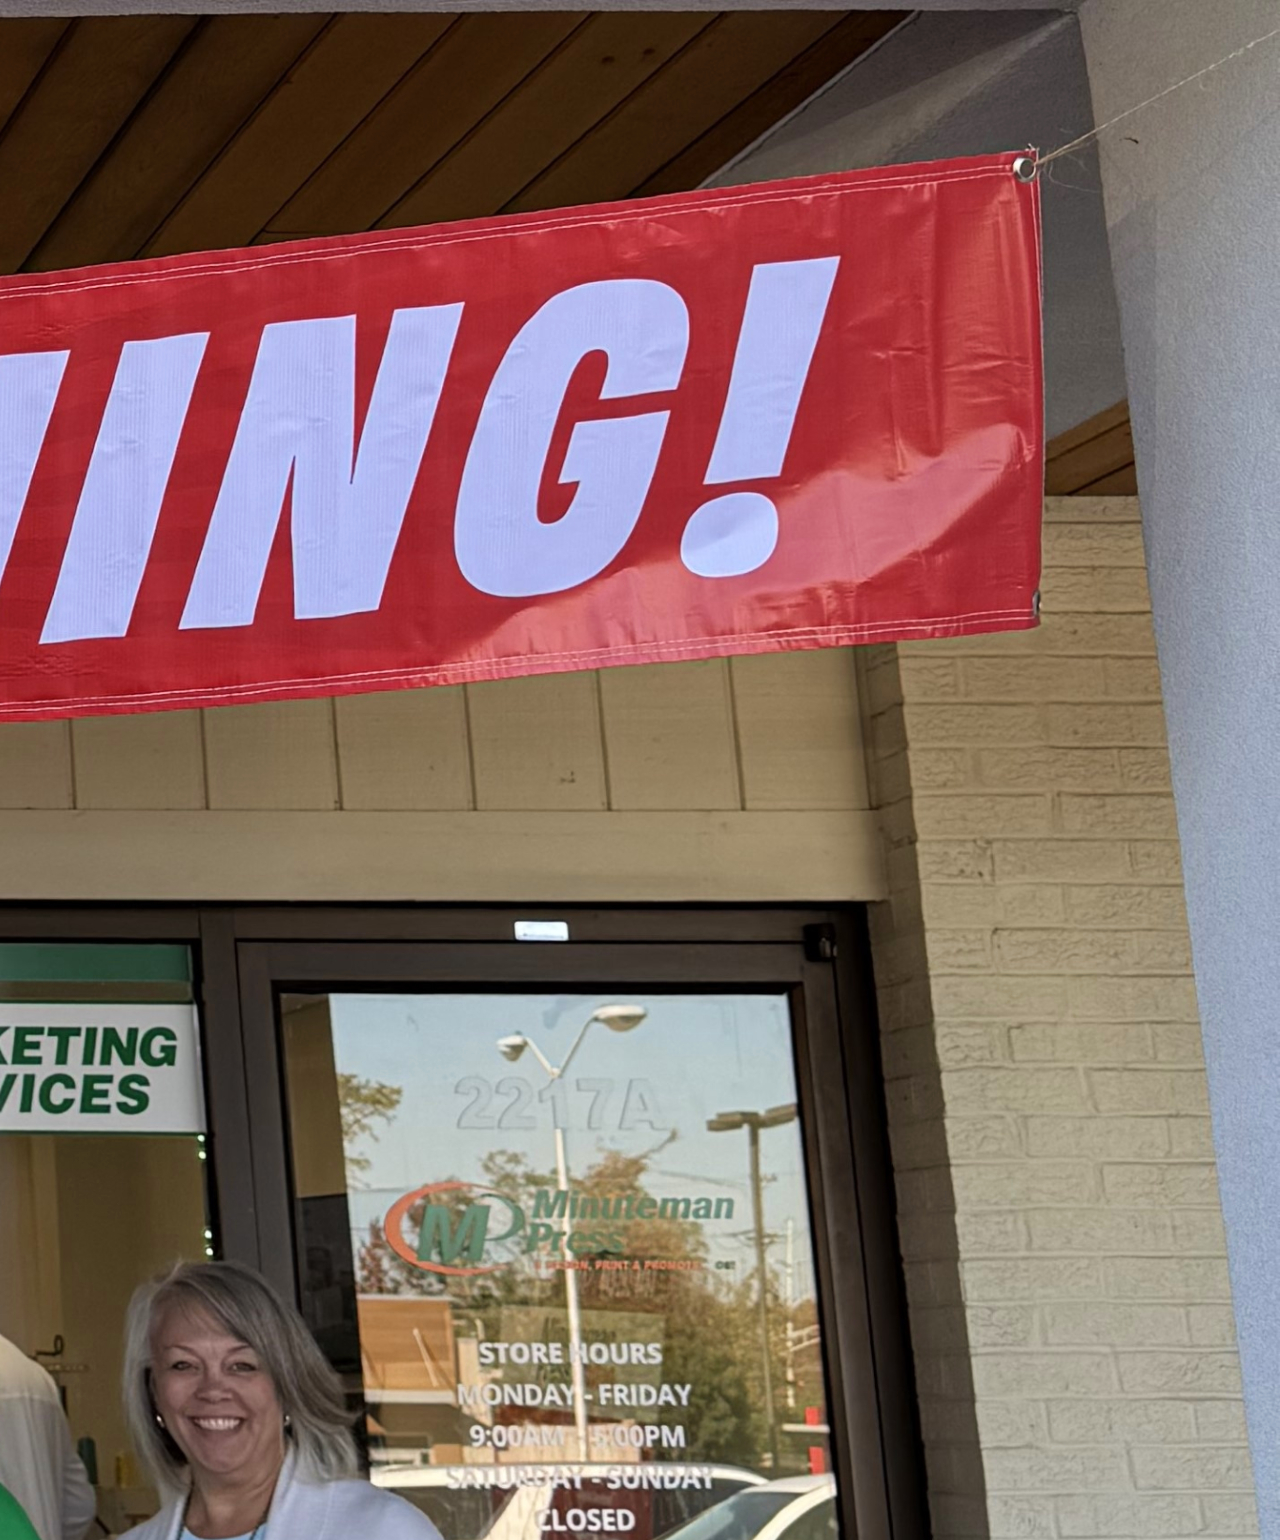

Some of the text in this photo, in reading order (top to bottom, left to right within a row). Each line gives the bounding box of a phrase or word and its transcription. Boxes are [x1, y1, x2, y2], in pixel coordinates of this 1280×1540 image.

[454, 1076, 670, 1131] 2217A
[532, 1189, 734, 1220] Minuteman
[526, 1222, 626, 1253] Press
[479, 1342, 663, 1366] STORE HOURS
[458, 1383, 575, 1406] MONDAY
[599, 1383, 692, 1406] FRIDAY
[470, 1424, 565, 1448] 9:00AM
[592, 1424, 686, 1448] 5:00PM
[446, 1465, 583, 1490] SATURDAY
[607, 1465, 713, 1490] SUNDAY
[536, 1508, 636, 1532] CLOSED
